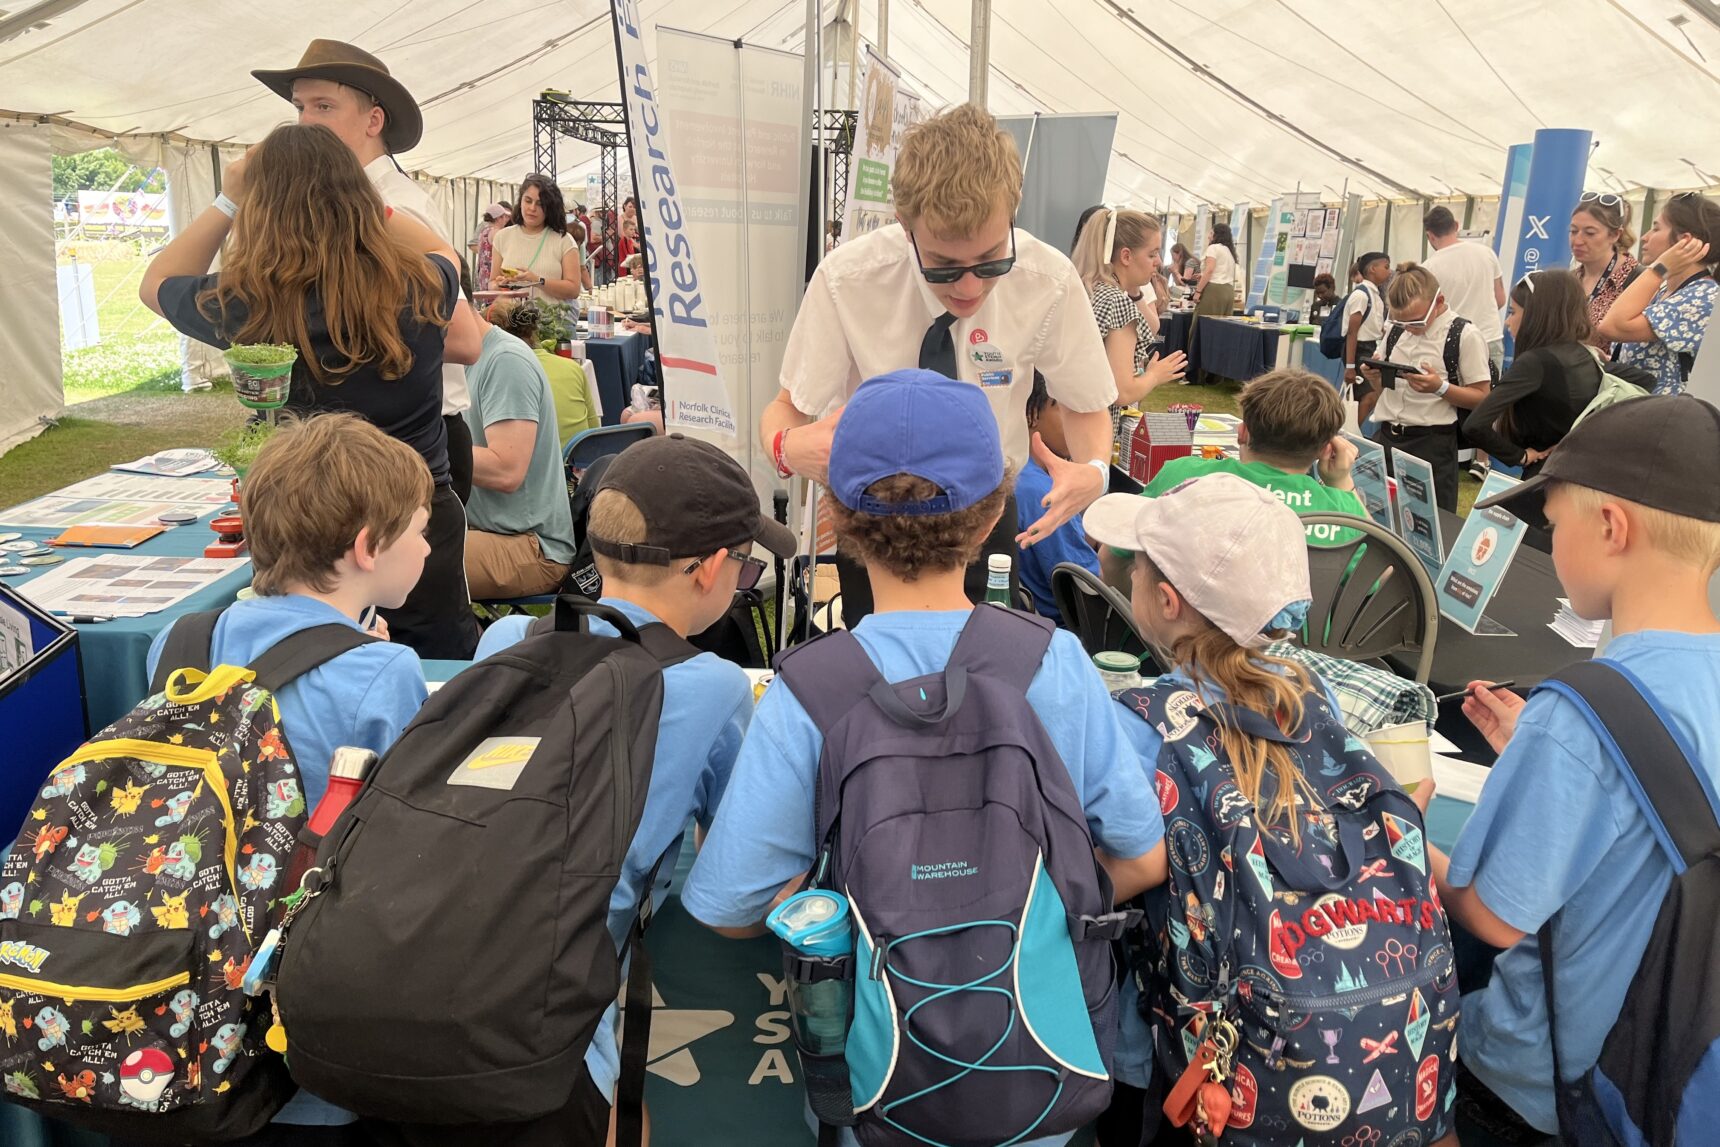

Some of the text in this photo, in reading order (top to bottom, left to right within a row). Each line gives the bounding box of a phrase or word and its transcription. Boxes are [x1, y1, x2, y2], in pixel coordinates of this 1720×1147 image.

[634, 64, 708, 328] Research
[680, 401, 731, 419] Norfolk Clinica
[679, 411, 714, 425] Research
[157, 706, 186, 716] CATCH
[167, 770, 194, 778] GOTTA
[168, 782, 188, 790] ALL!
[68, 801, 88, 824] CATCH
[80, 801, 98, 822] GOTTA
[70, 815, 83, 830] ALL!
[262, 822, 285, 845] CATCH
[274, 822, 295, 845] GOTTA
[265, 836, 283, 852] ALL!
[1395, 835, 1420, 857] HISTORY
[917, 861, 967, 872] MOUNTAIN
[917, 867, 978, 880] WAREHOUSE
[102, 876, 131, 885] GOTTA
[193, 875, 220, 888] CATCH
[205, 882, 221, 891] ALL
[92, 885, 121, 893] CATCH
[104, 891, 123, 899] ALL!
[1280, 896, 1436, 961] OGWARTS
[1326, 926, 1364, 941] POTIONS
[199, 1000, 221, 1012] OTTA
[199, 1011, 214, 1020] TCH
[202, 1015, 221, 1028] ALL!
[1298, 1111, 1341, 1121] POTIONS
